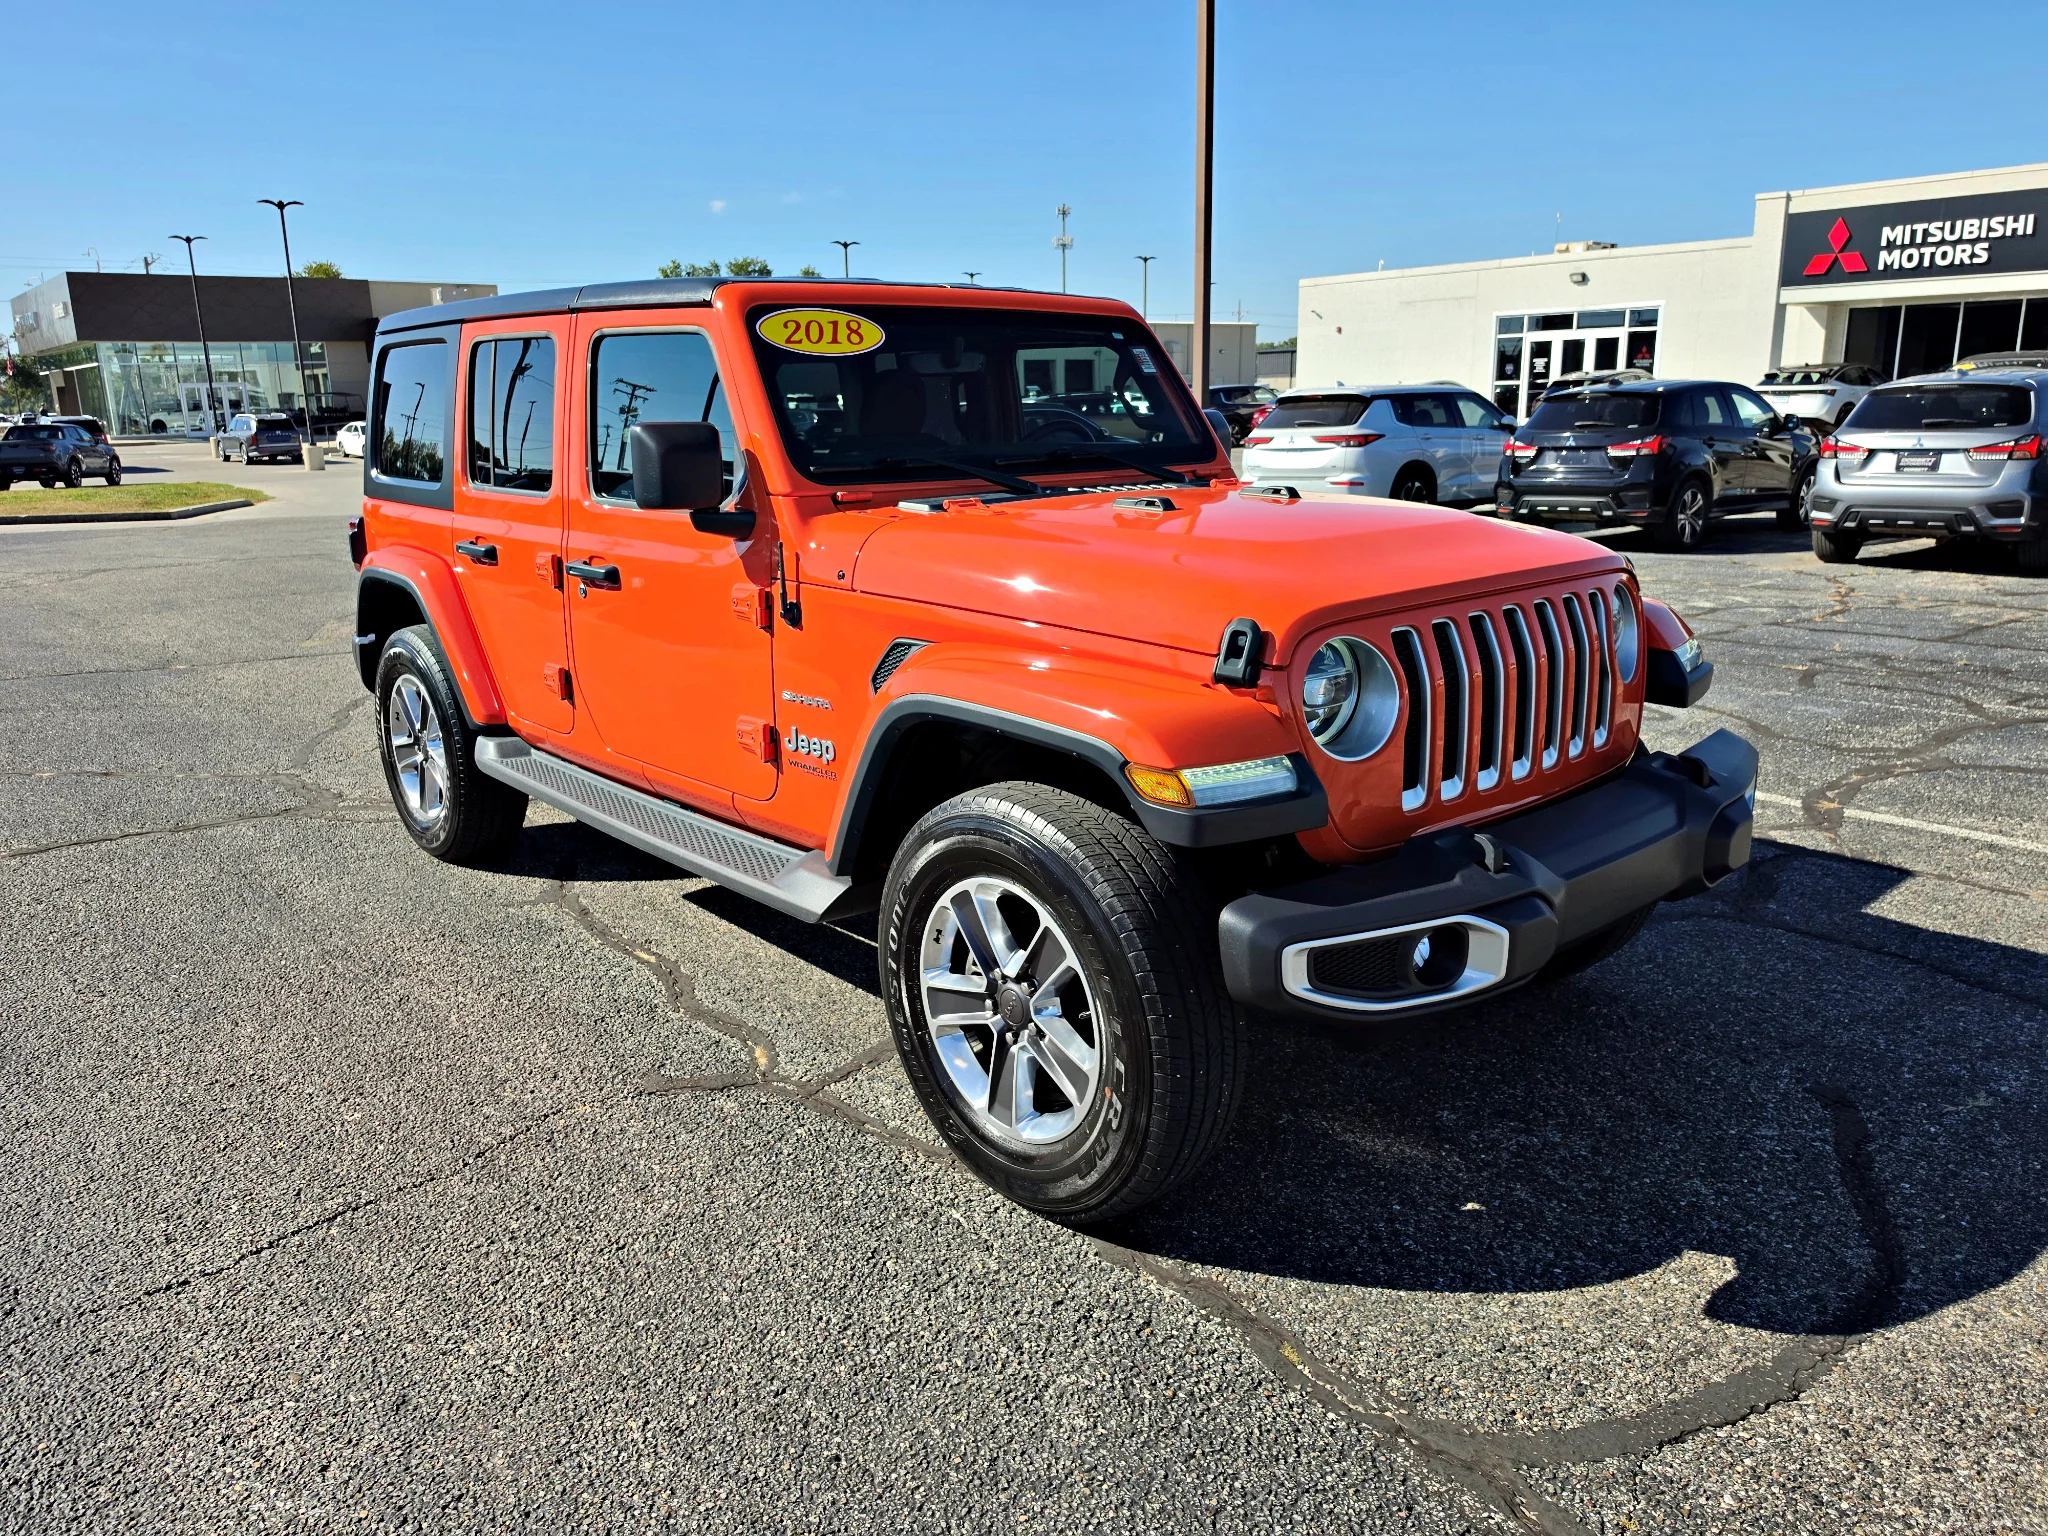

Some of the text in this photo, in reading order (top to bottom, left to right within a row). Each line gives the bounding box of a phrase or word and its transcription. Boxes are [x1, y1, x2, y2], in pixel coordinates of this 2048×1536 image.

[1880, 213, 2035, 247] MITSUBISHI
[1877, 242, 1990, 271] MOTORS
[782, 319, 864, 346] 2018
[782, 691, 834, 711] SAHARA
[784, 726, 836, 766] Jeep
[788, 758, 838, 779] WRANGLER
